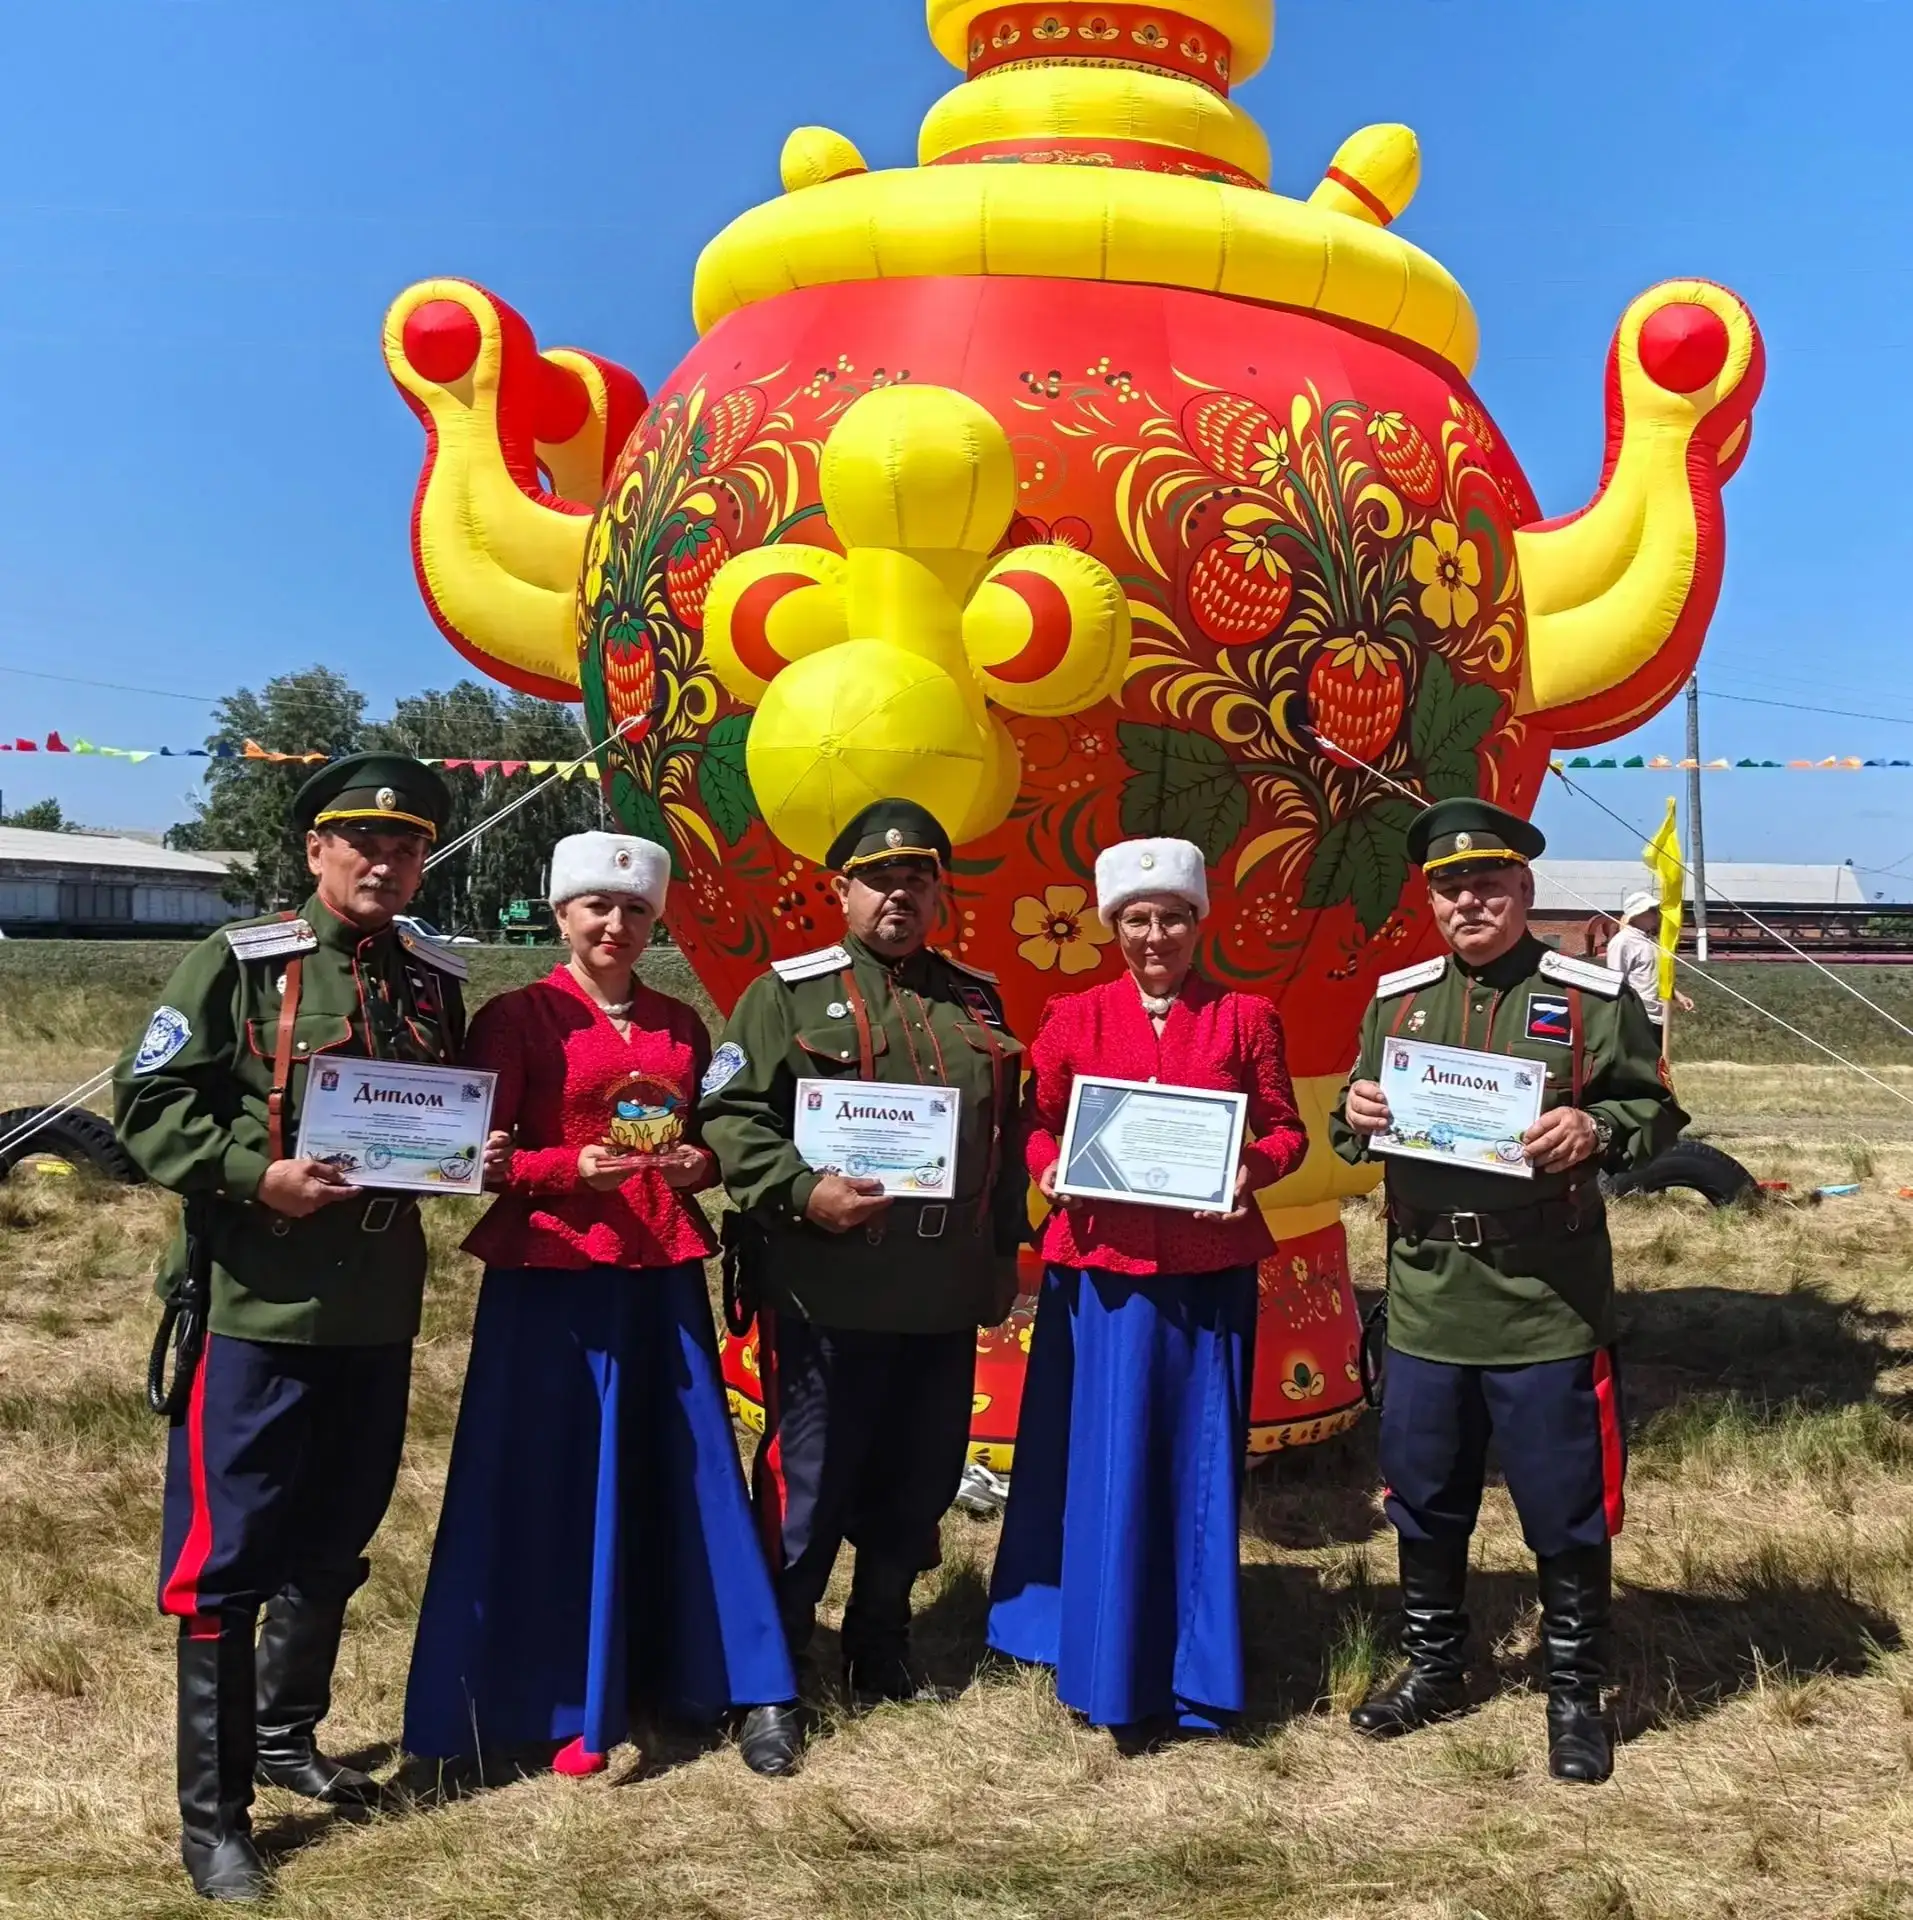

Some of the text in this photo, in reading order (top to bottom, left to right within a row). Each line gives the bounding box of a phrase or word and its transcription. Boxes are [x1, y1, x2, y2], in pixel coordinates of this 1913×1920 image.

[1530, 1002, 1569, 1036] Z
[1421, 1064, 1500, 1092] Диплом
[353, 1082, 444, 1107] Диплом
[835, 1100, 915, 1122] Диплом
